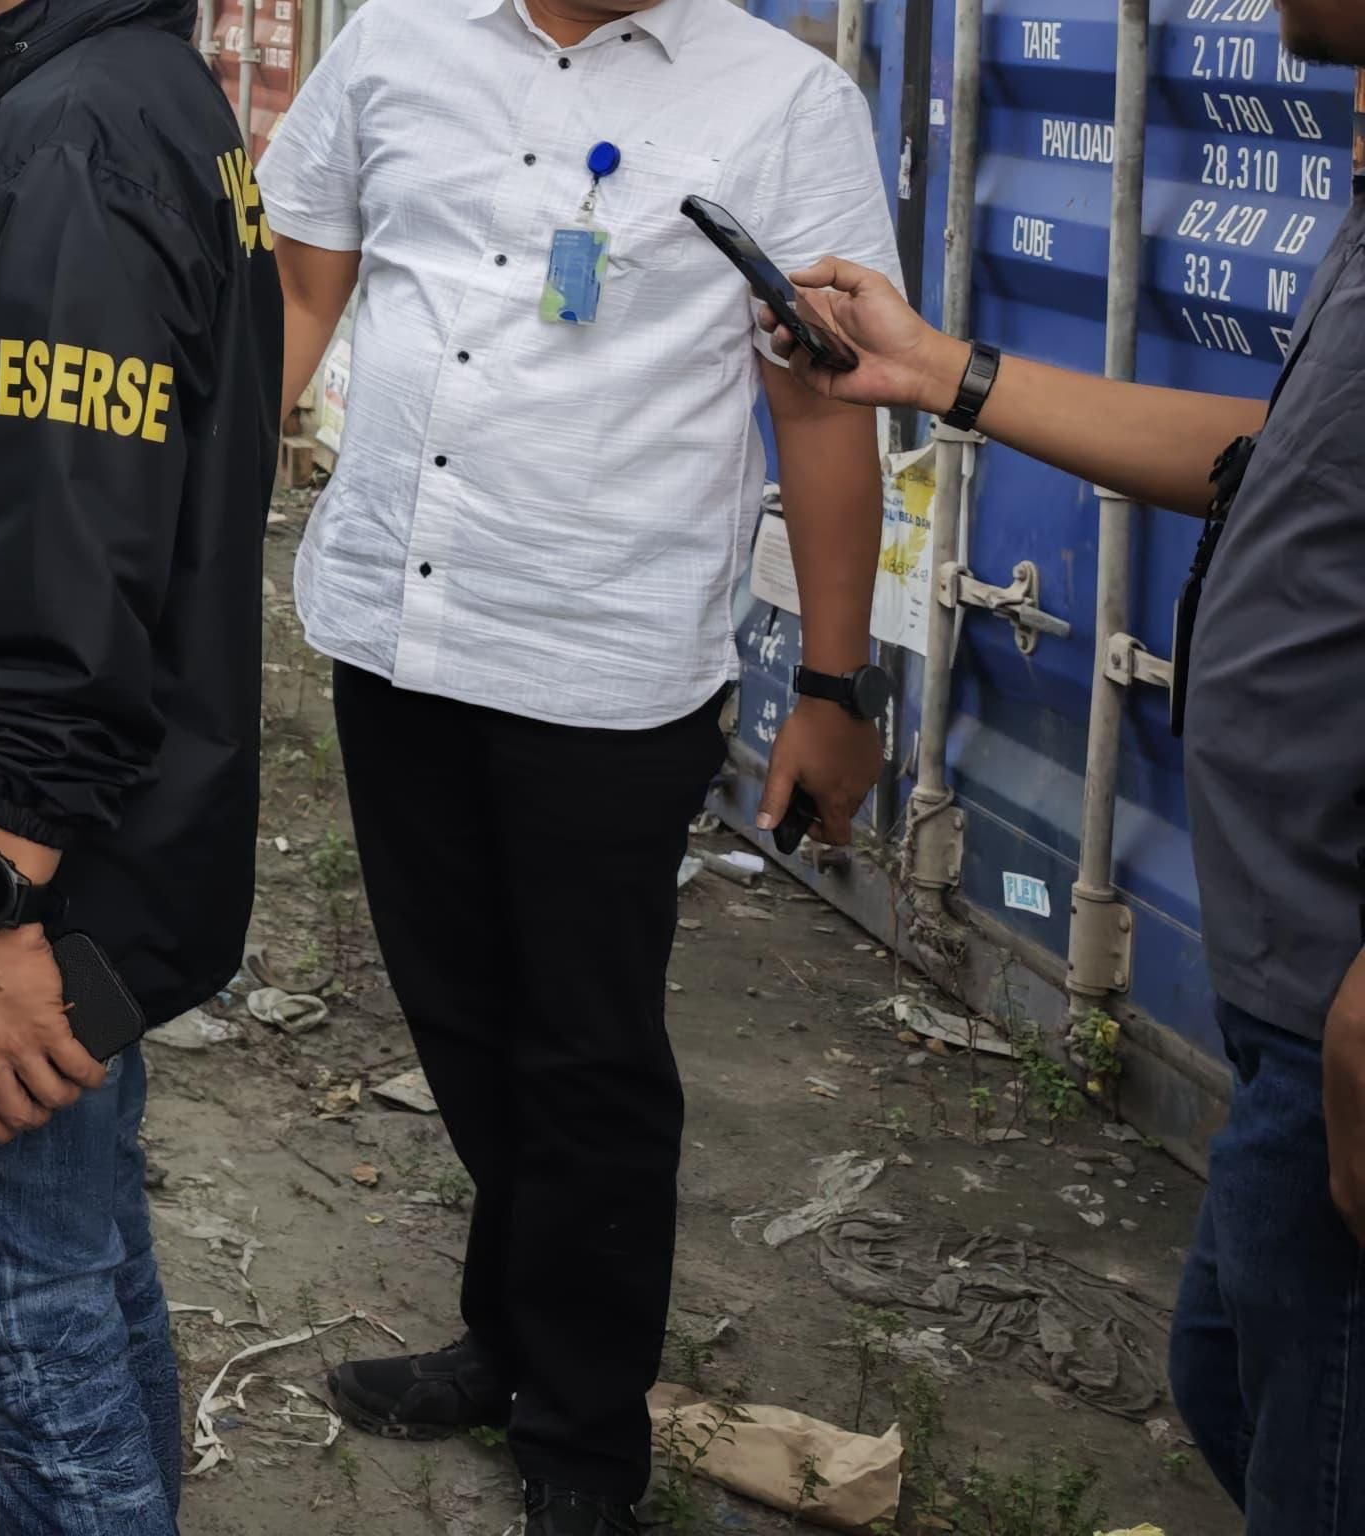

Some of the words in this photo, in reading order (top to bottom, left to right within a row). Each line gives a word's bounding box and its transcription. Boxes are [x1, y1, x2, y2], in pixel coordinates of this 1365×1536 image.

[1021, 20, 1063, 61] TARE
[1191, 35, 1256, 82] 2,170
[1201, 92, 1274, 136] 4,780
[1282, 98, 1323, 141] LB
[1041, 118, 1116, 164] PAYLOAD
[1201, 143, 1279, 193] 28,310
[1300, 154, 1332, 201] KG
[1176, 198, 1268, 248] 62,420
[1273, 212, 1316, 256] LB
[1012, 214, 1056, 263] CUBE
[1183, 253, 1232, 304] 33.2
[1181, 306, 1253, 357] 1,170
